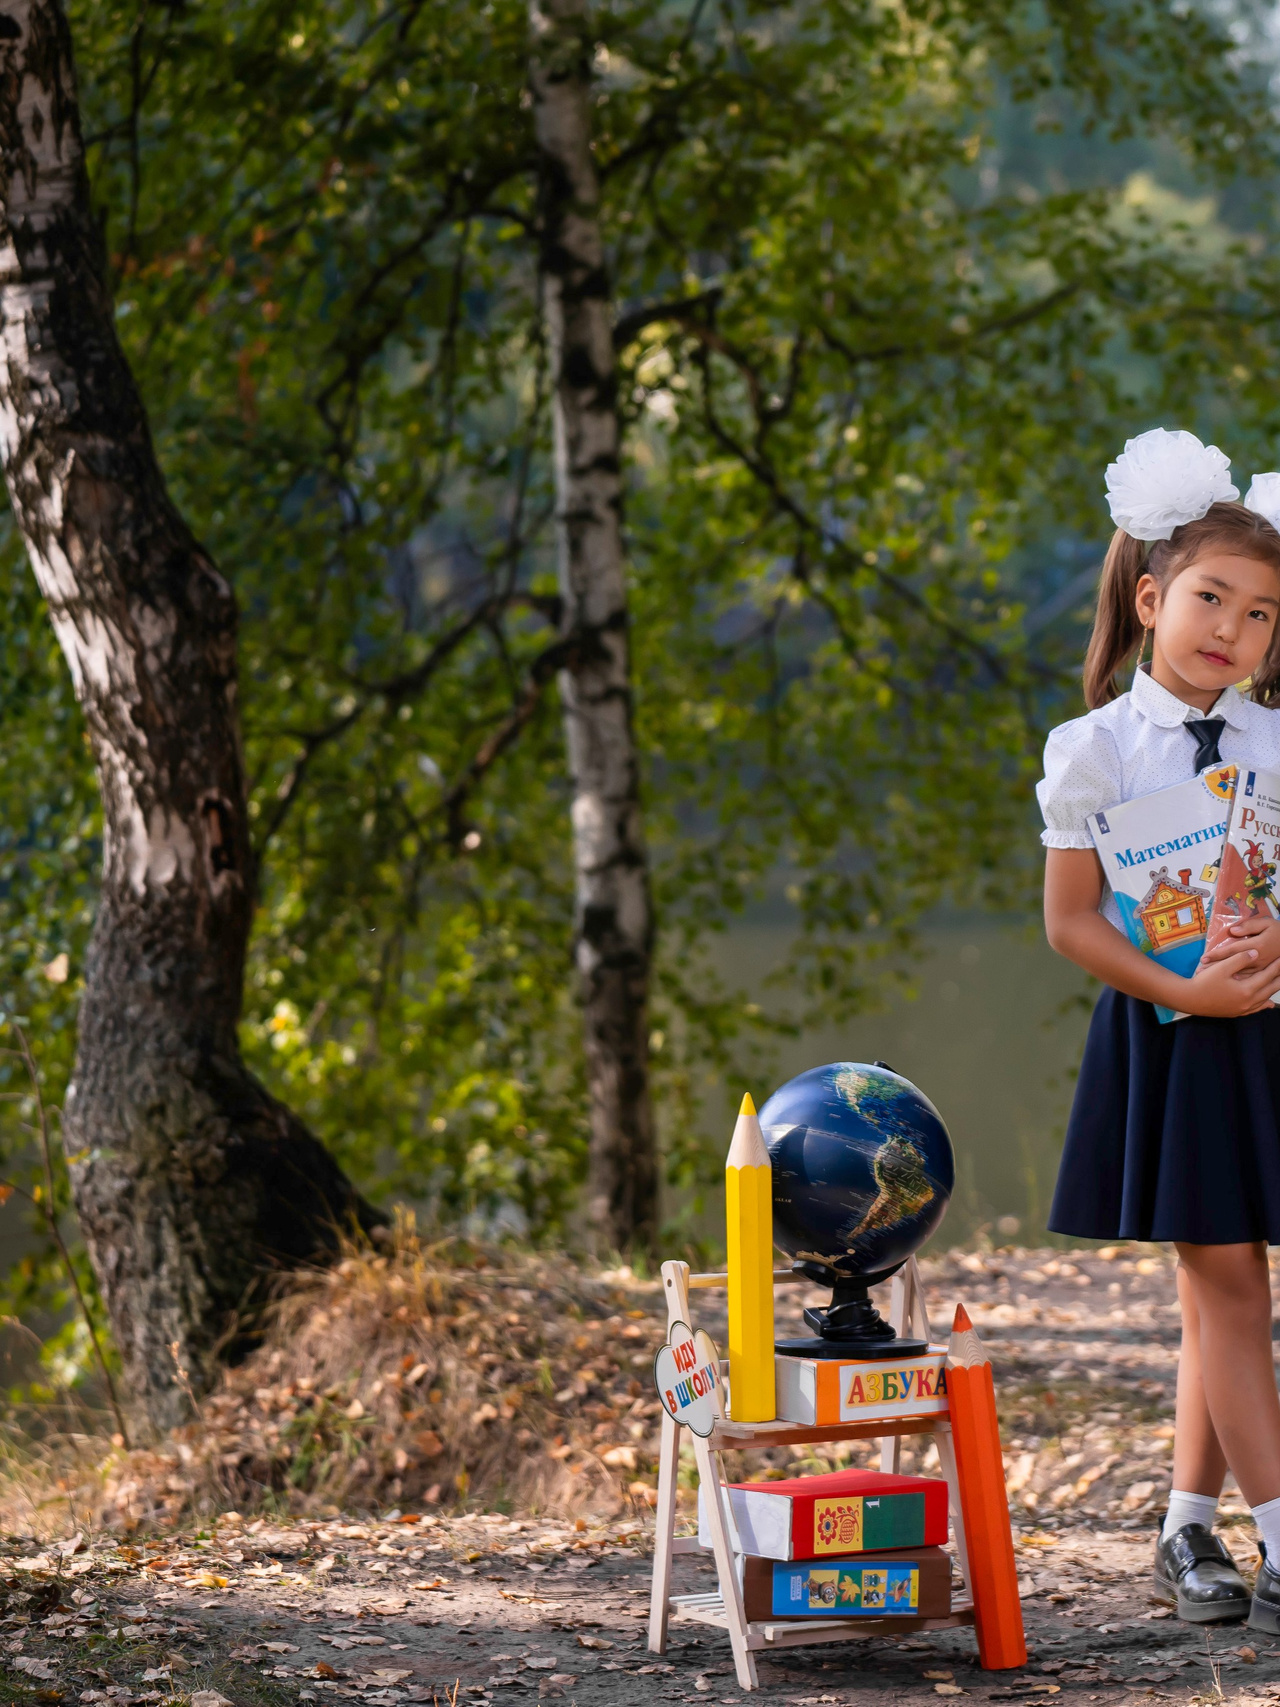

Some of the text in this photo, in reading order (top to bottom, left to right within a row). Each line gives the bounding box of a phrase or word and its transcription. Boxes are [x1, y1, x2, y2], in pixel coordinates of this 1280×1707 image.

[1114, 821, 1227, 870] Математик
[672, 1339, 697, 1374] ИДУ
[665, 1362, 720, 1414] В ШКОЛУ!
[848, 1367, 948, 1404] АЗБУКА
[866, 1498, 880, 1509] 1
